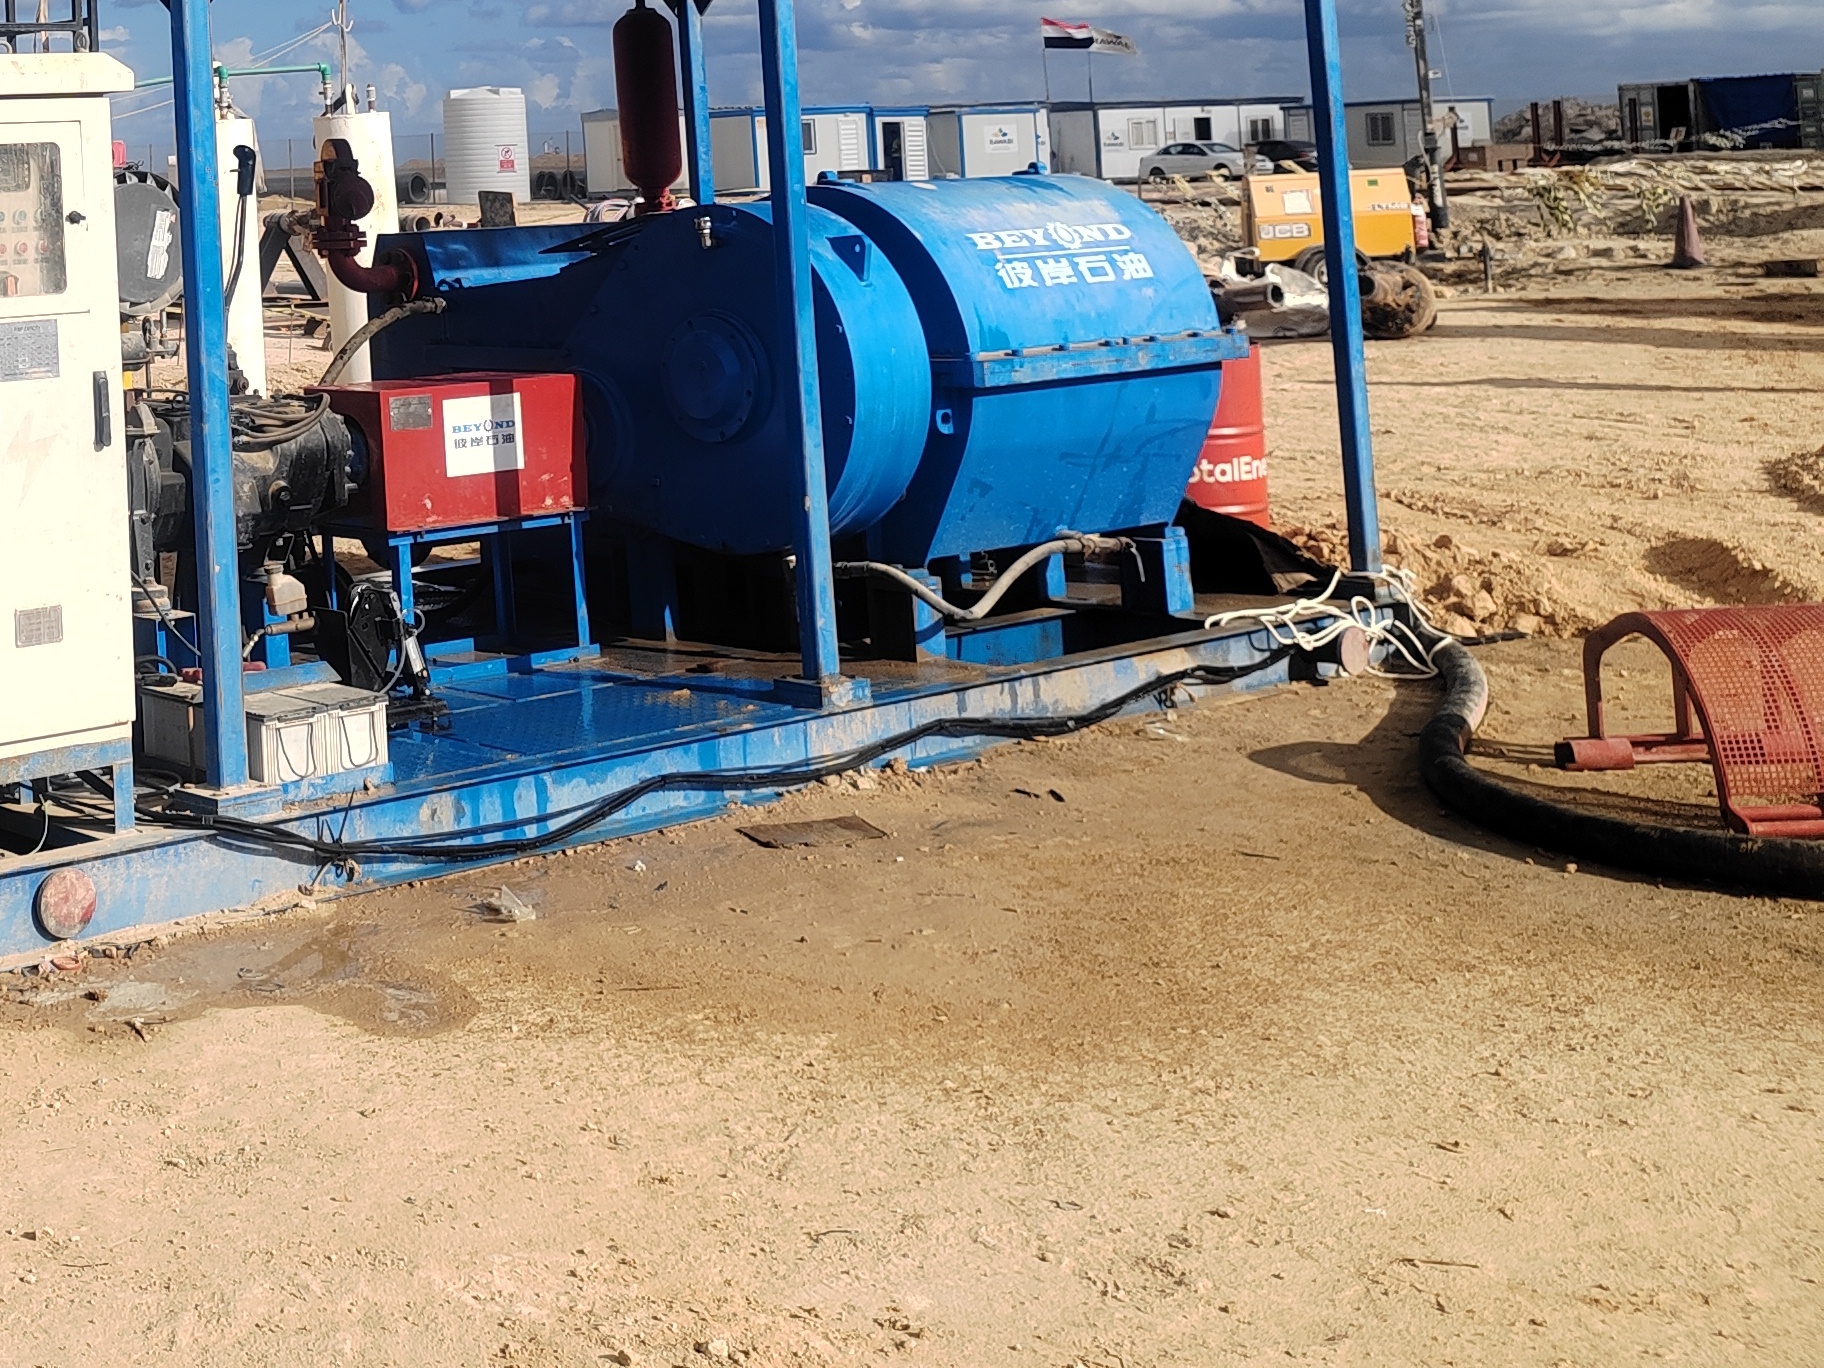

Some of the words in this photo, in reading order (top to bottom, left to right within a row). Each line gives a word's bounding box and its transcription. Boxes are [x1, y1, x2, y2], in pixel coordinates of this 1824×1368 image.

[966, 221, 1132, 250] BEYOND
[1259, 223, 1311, 240] JCB
[995, 252, 1154, 289] 彼岸石油
